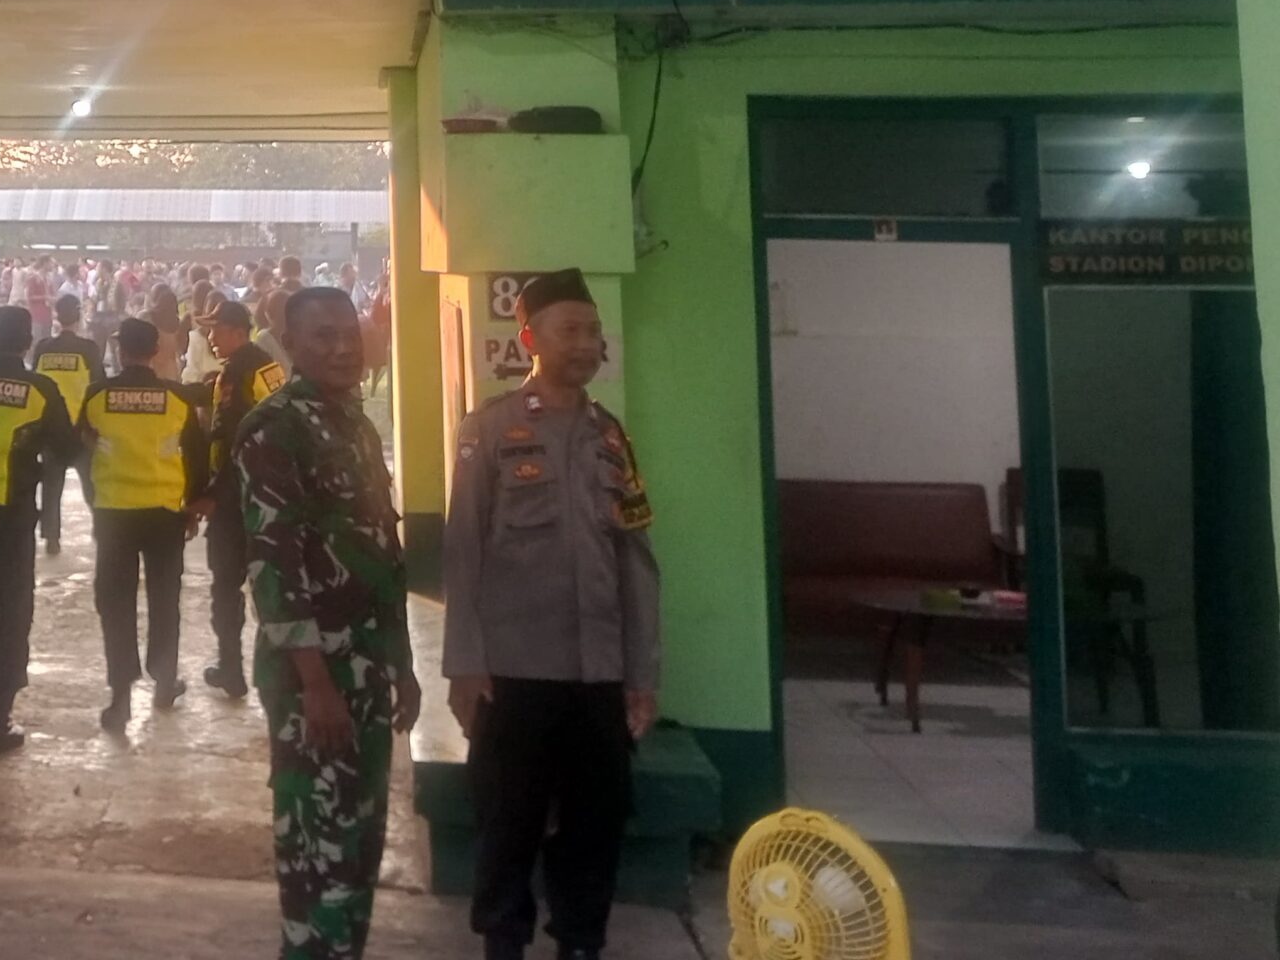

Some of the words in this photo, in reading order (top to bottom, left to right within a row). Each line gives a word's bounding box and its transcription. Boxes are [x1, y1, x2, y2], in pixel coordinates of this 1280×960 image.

[1048, 227, 1166, 245] KANTOR
[1048, 255, 1166, 274] STADION
[108, 391, 165, 404] SENKOM
